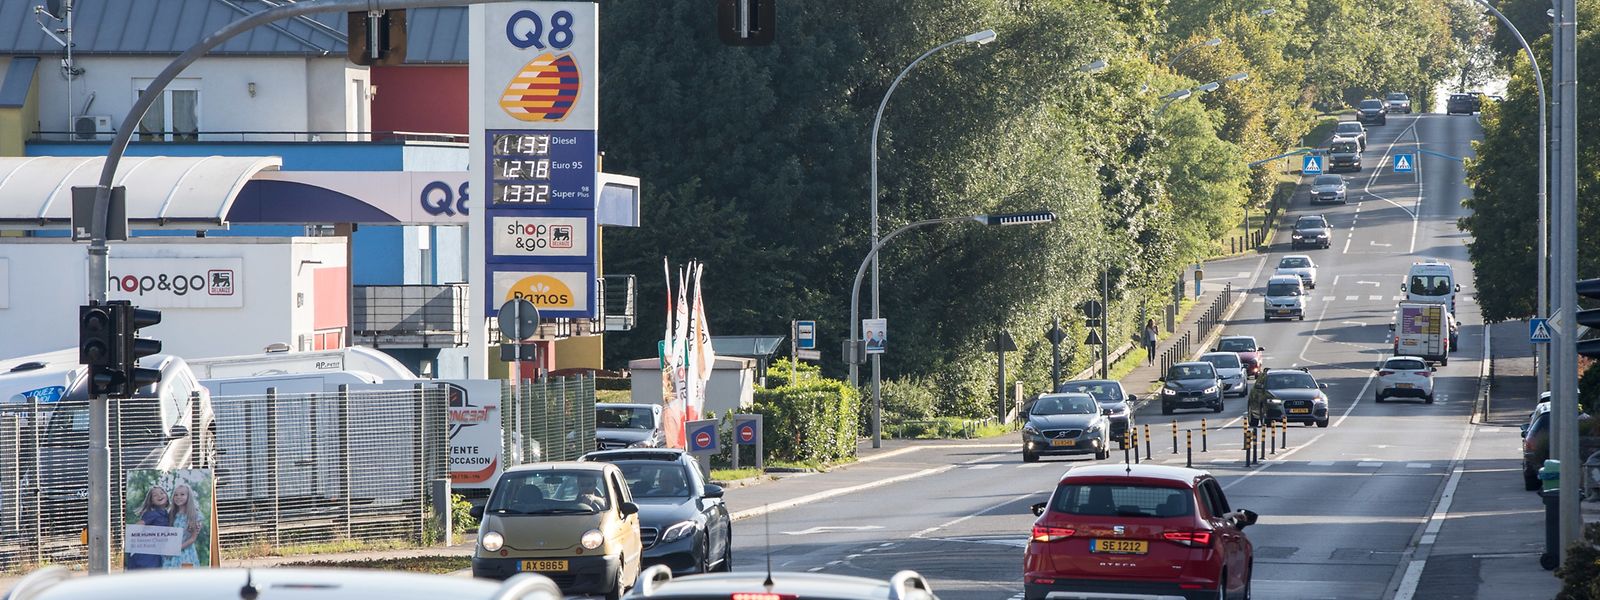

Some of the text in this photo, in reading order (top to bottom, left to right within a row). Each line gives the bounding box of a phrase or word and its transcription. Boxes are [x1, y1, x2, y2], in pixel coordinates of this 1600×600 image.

[506, 9, 574, 50] Q8
[503, 136, 577, 154] 1.133 Diesel
[503, 160, 583, 178] 1.278 Euro 95
[420, 181, 469, 217] Q8
[503, 185, 549, 202] 1.332
[552, 189, 576, 199] Super
[507, 220, 547, 237] shop
[515, 237, 547, 252] &go
[514, 291, 568, 304] Panos
[1102, 541, 1141, 551] SE 1212
[526, 561, 564, 570] AX 9865
